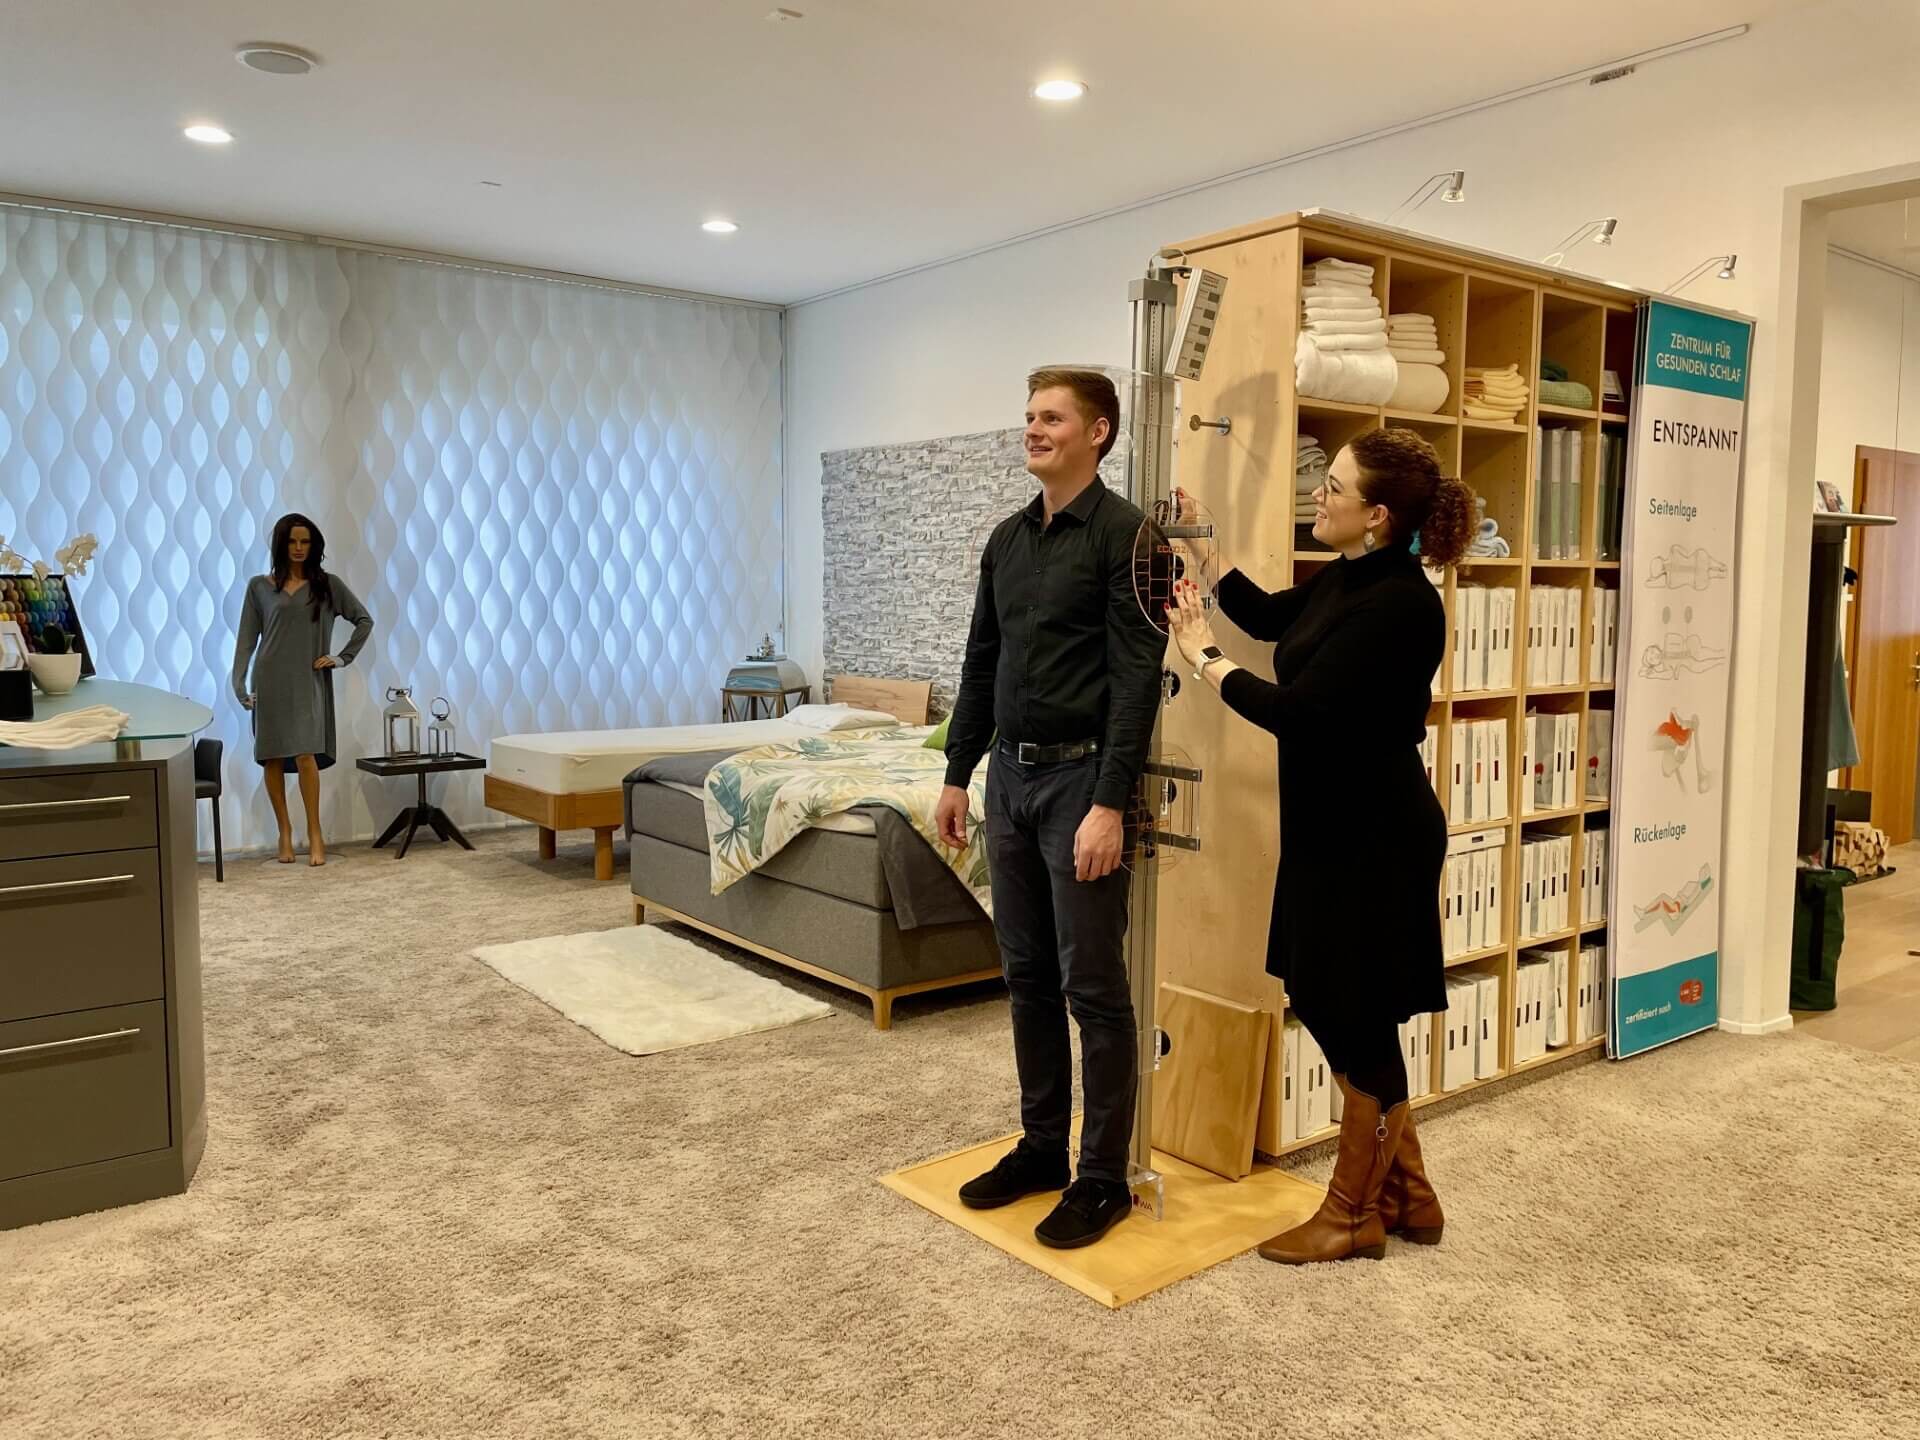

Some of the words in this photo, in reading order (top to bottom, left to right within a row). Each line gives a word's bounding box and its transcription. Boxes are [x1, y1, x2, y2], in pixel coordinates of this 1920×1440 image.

[1670, 333, 1712, 356] ZENTRUM
[1715, 340, 1731, 360] FÜR
[1656, 352, 1707, 377] GESUNDEN
[1709, 363, 1741, 383] SCHLAF
[1653, 419, 1738, 452] ENTSPANNT
[1649, 498, 1697, 522] Seitenlage
[1634, 820, 1687, 844] Rückenlage
